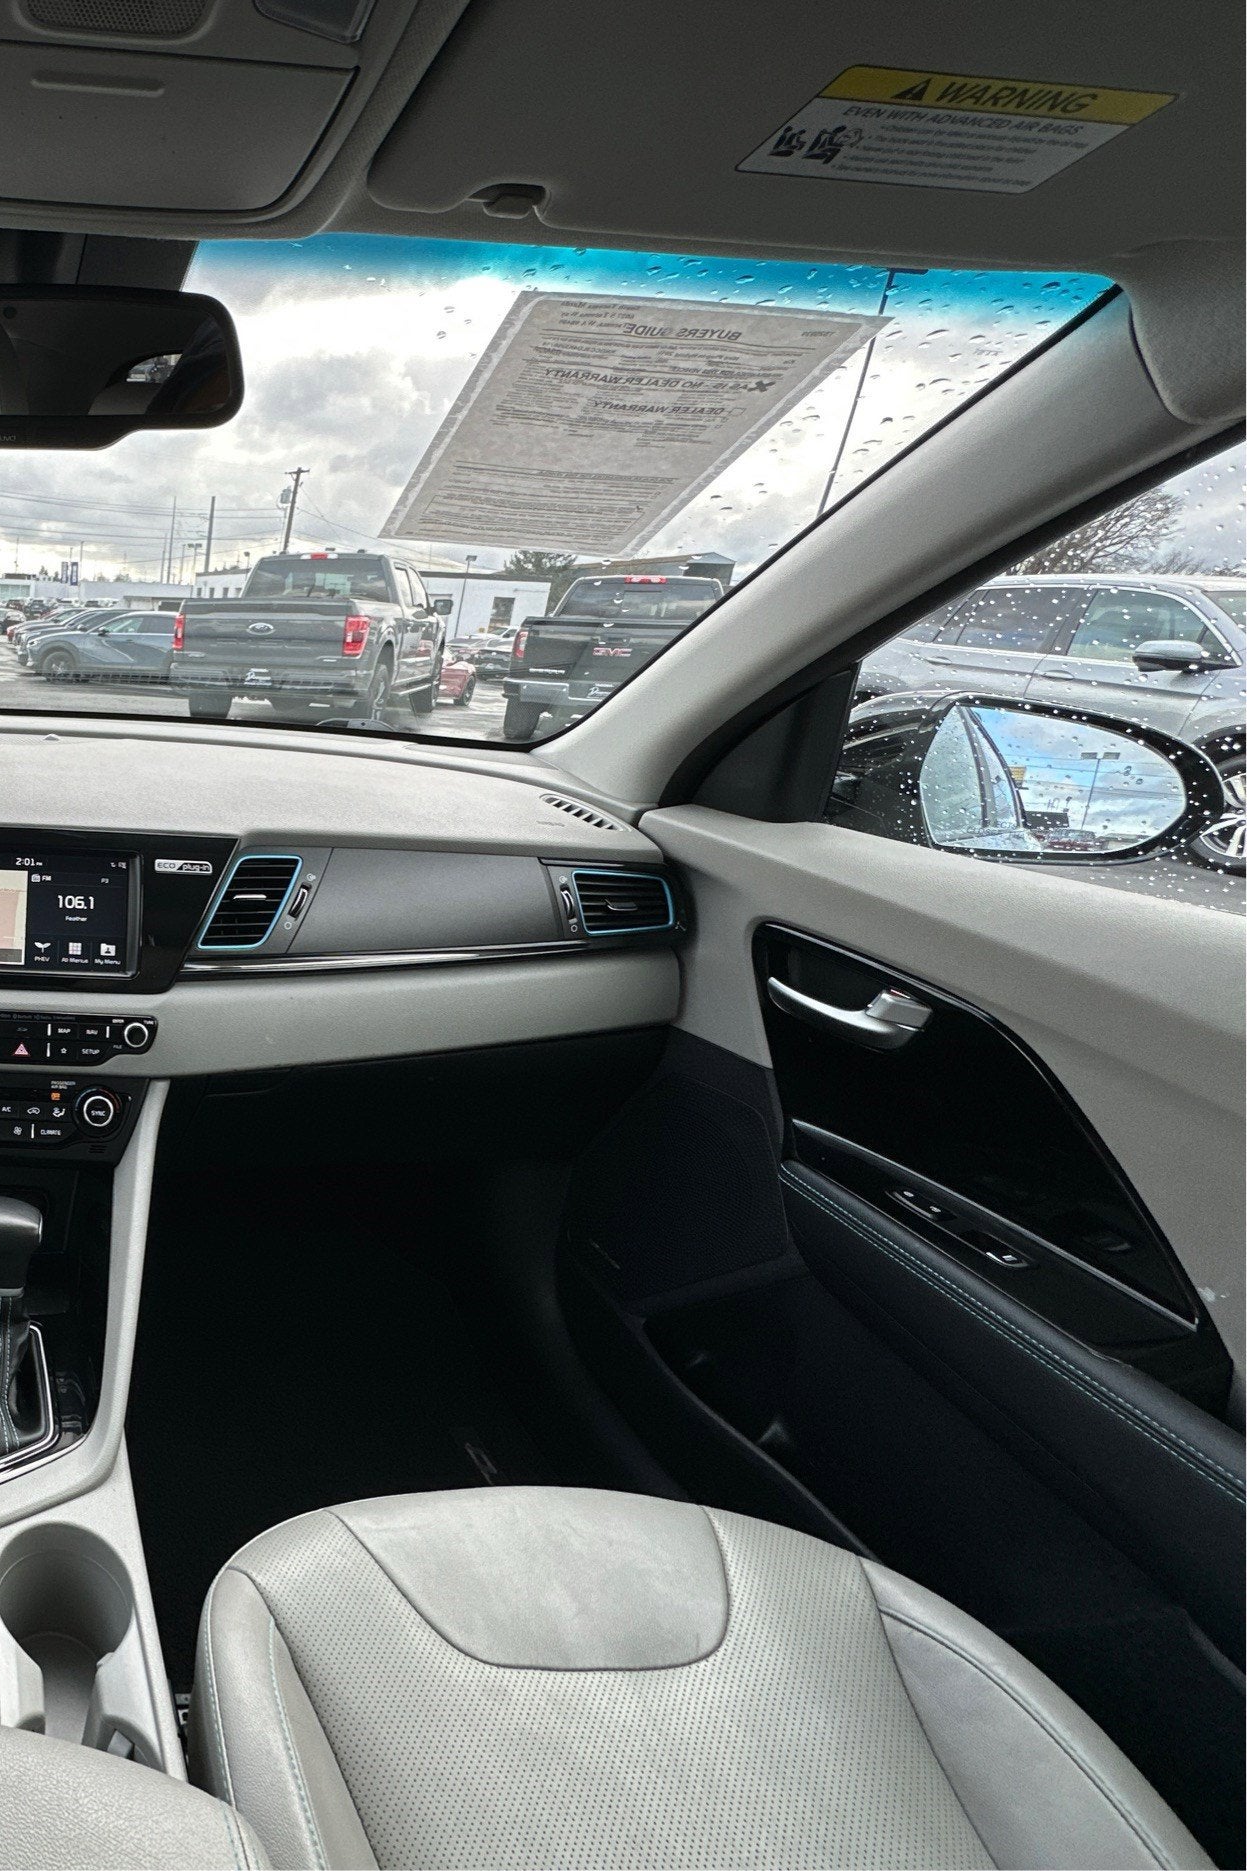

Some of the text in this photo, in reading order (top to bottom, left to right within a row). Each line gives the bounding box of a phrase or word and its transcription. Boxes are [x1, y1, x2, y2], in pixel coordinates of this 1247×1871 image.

[936, 81, 1098, 114] WARNING
[843, 105, 1084, 135] EVEN WITH ADVANCED AIR BAGS
[593, 647, 633, 658] GMC
[15, 857, 36, 866] 2:01
[182, 863, 210, 871] plug-in
[57, 894, 95, 910] 106.1
[94, 958, 104, 966] My
